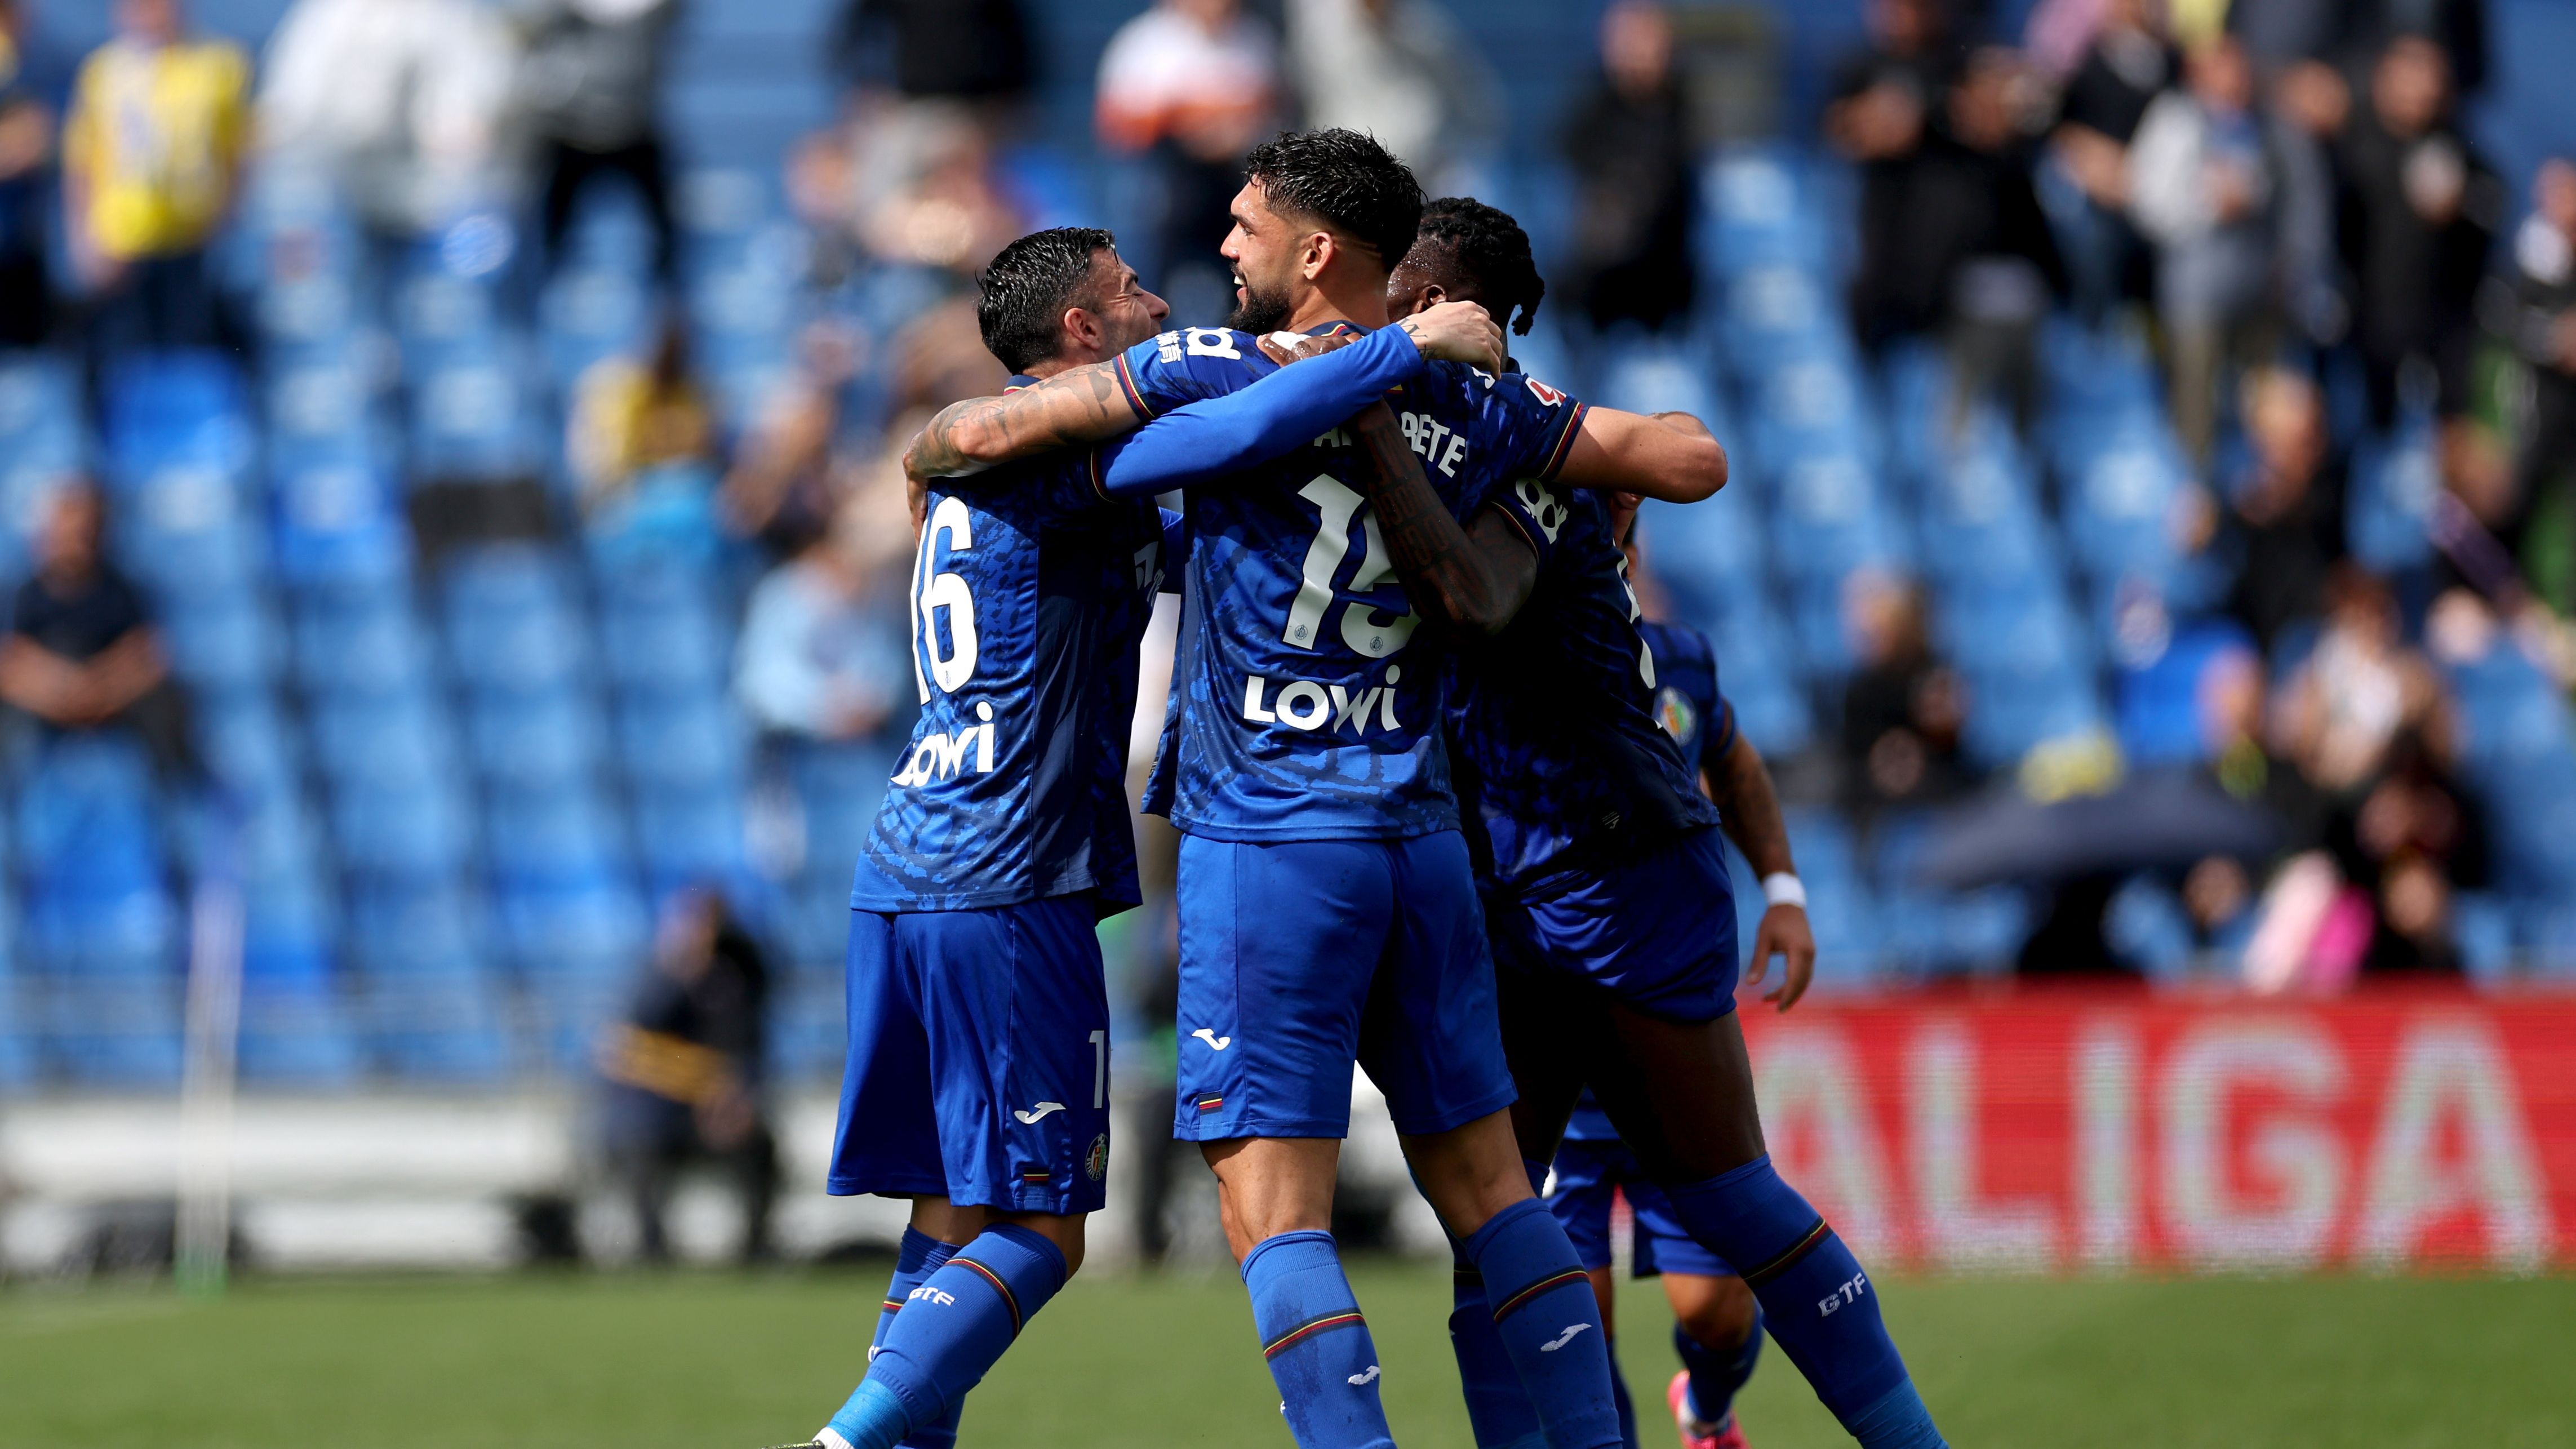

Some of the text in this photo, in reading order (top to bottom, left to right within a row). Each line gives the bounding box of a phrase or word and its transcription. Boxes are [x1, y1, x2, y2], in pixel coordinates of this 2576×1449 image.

[1314, 411, 1465, 478] ARETE
[911, 496, 978, 705] 16
[1282, 473, 1422, 658] 15
[1089, 1030, 1111, 1109] 1
[1751, 1017, 2552, 1265] ALIGA
[909, 1287, 955, 1306] GTF
[1818, 1272, 1866, 1317] GTF
